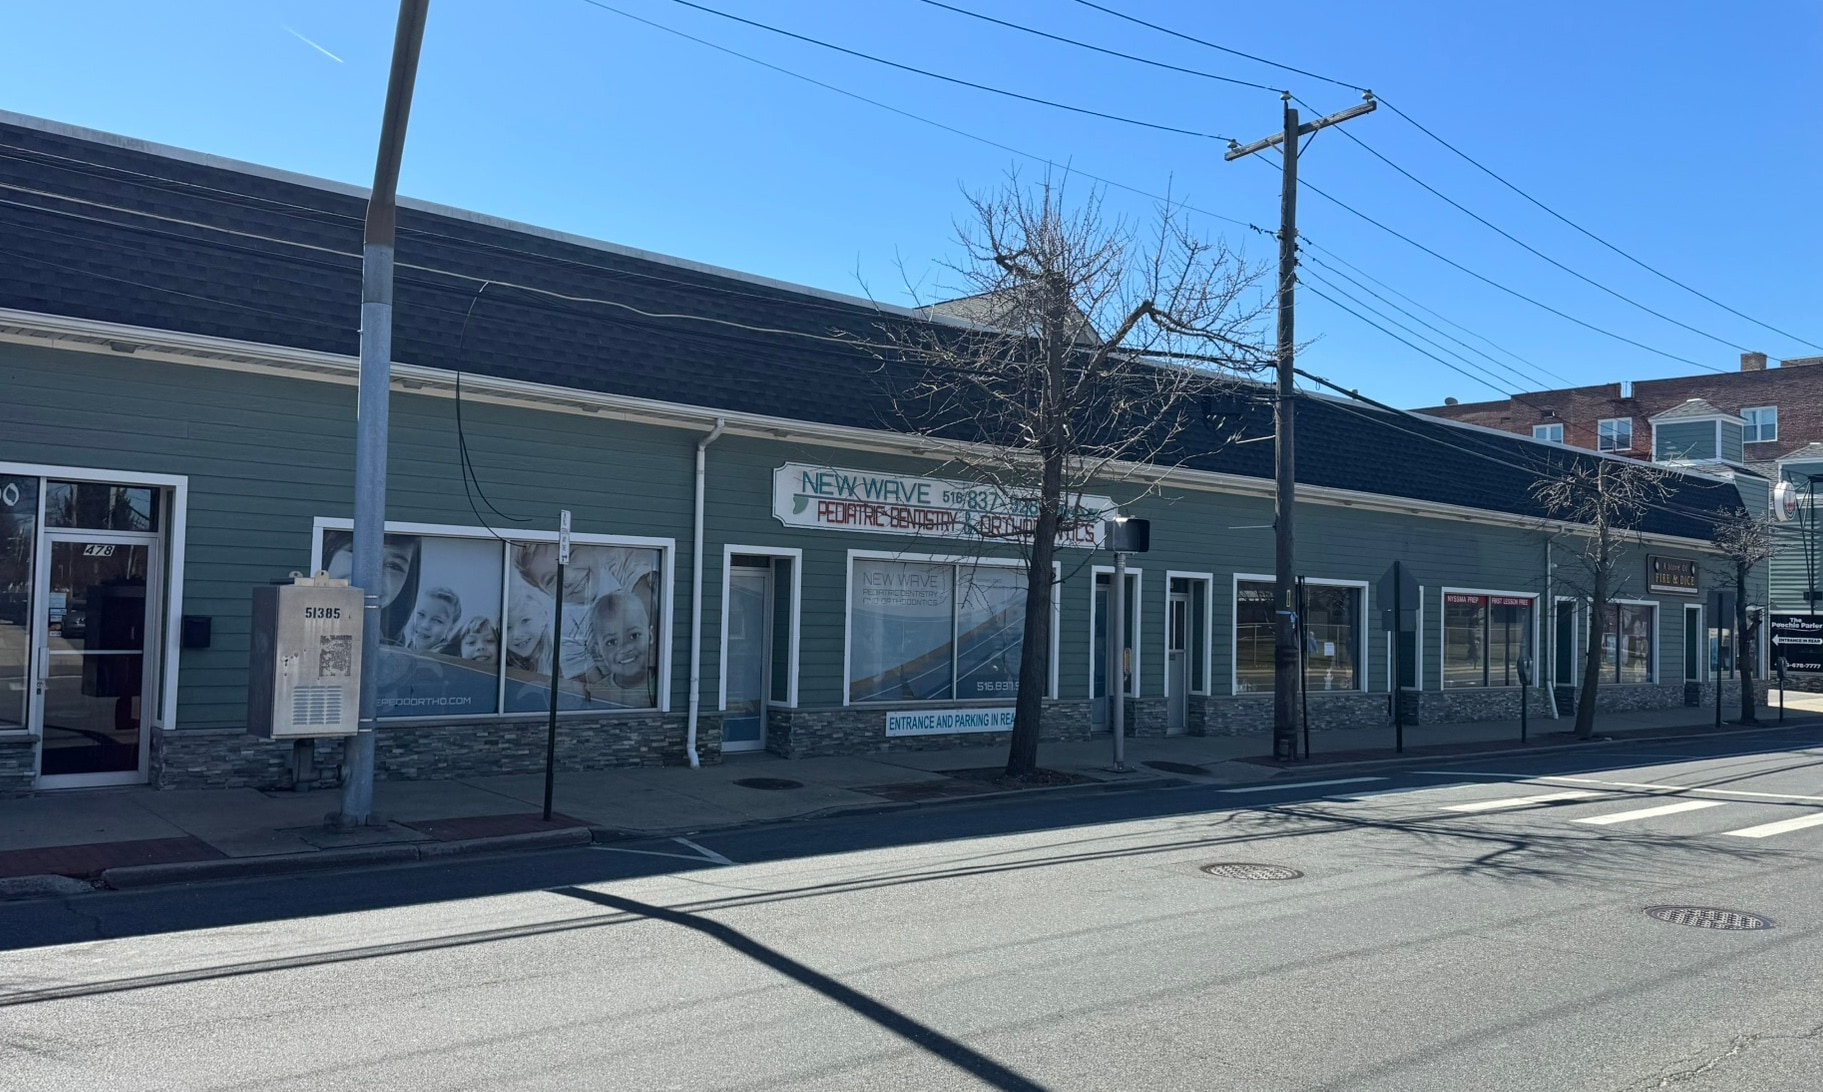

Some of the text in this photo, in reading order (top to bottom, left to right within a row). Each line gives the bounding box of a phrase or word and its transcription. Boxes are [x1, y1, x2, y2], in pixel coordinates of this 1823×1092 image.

[802, 471, 857, 497] NEW
[862, 477, 931, 504] WAVE
[943, 490, 963, 504] 516
[817, 500, 885, 527] PEDIATRIC
[890, 506, 957, 532] DENTISTRY
[85, 545, 113, 556] 478
[863, 572, 938, 588] NEW WAVE
[1655, 572, 1696, 586] FIRE & DICE
[862, 588, 938, 598] PEDIATRIC DENTISTRY
[880, 598, 938, 607] ORTHODONTICS
[1447, 595, 1479, 604] NYSSMA PREP
[305, 607, 341, 619] 51385
[977, 681, 1020, 691] 516.837.9
[376, 697, 472, 707] EPEDOORTHO.COM
[889, 712, 1015, 731] ENTRANCE AND PARKING IN REA
